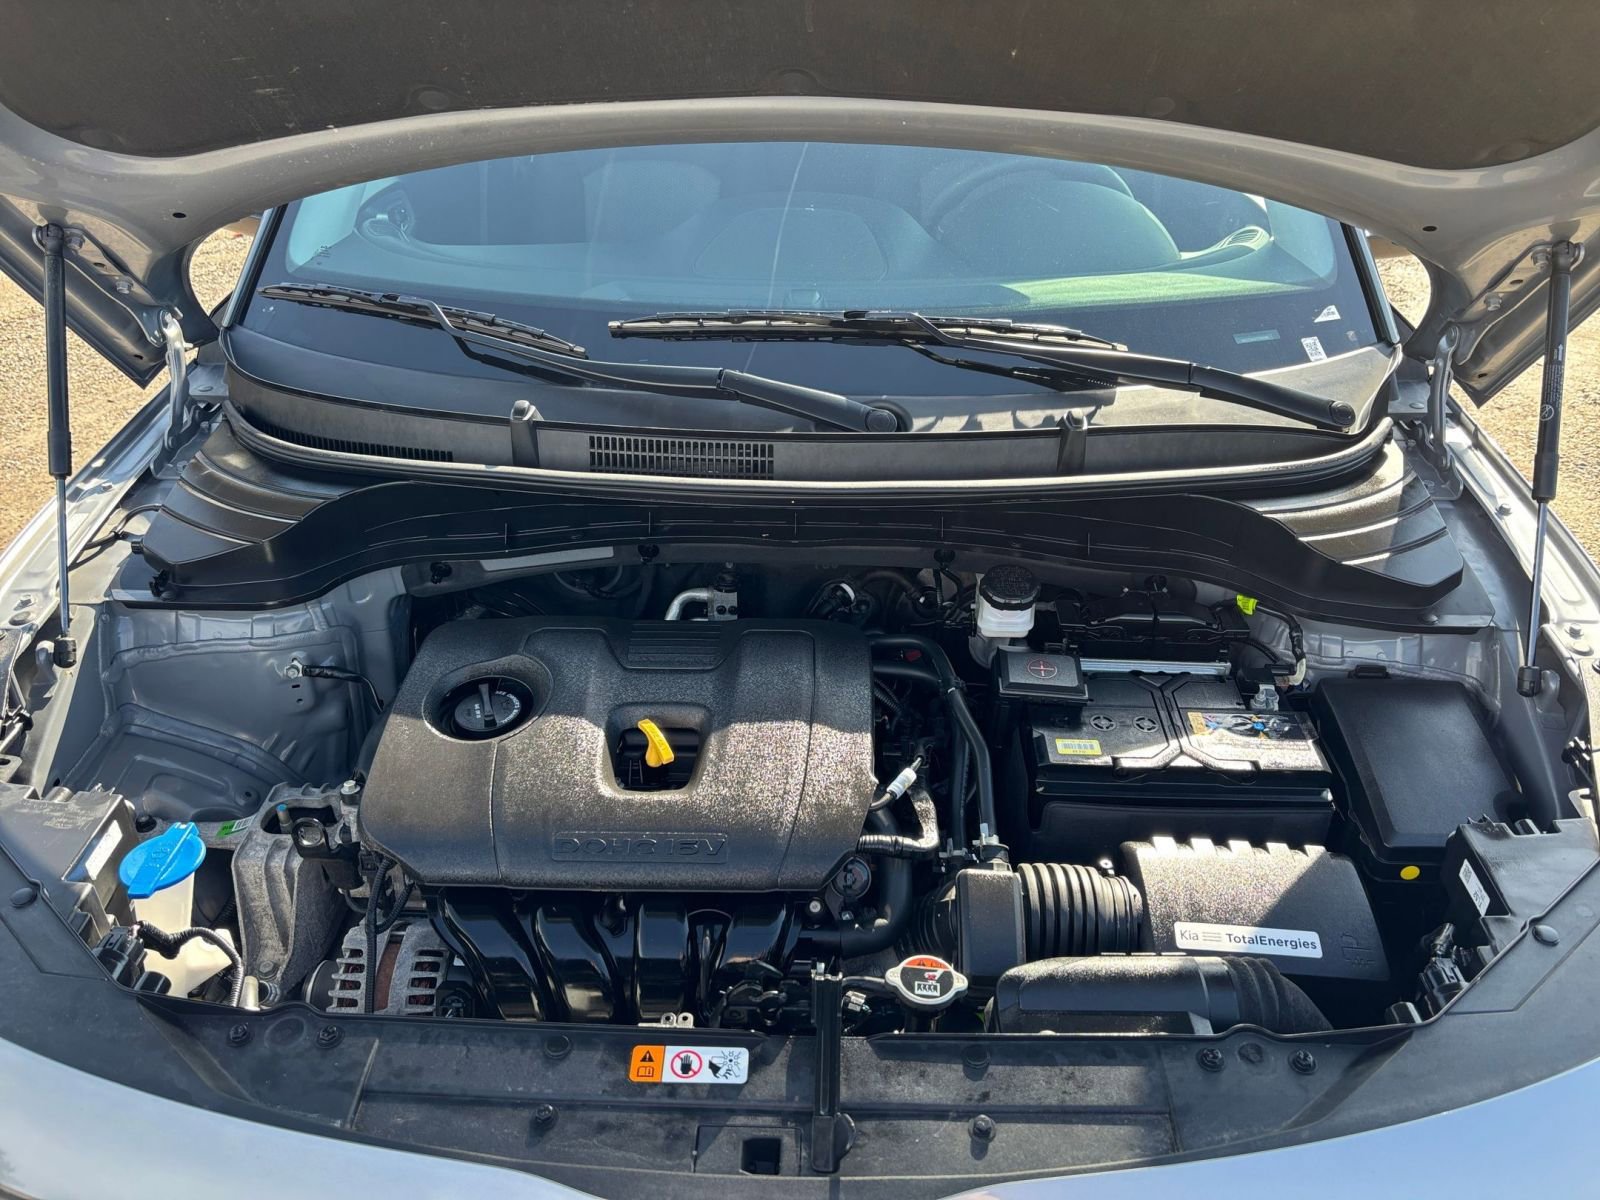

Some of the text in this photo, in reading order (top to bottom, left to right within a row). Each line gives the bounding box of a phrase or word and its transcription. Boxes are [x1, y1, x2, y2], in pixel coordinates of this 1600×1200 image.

[555, 838, 657, 855] DOHC
[1179, 929, 1317, 950] Kia TotalEnergies
